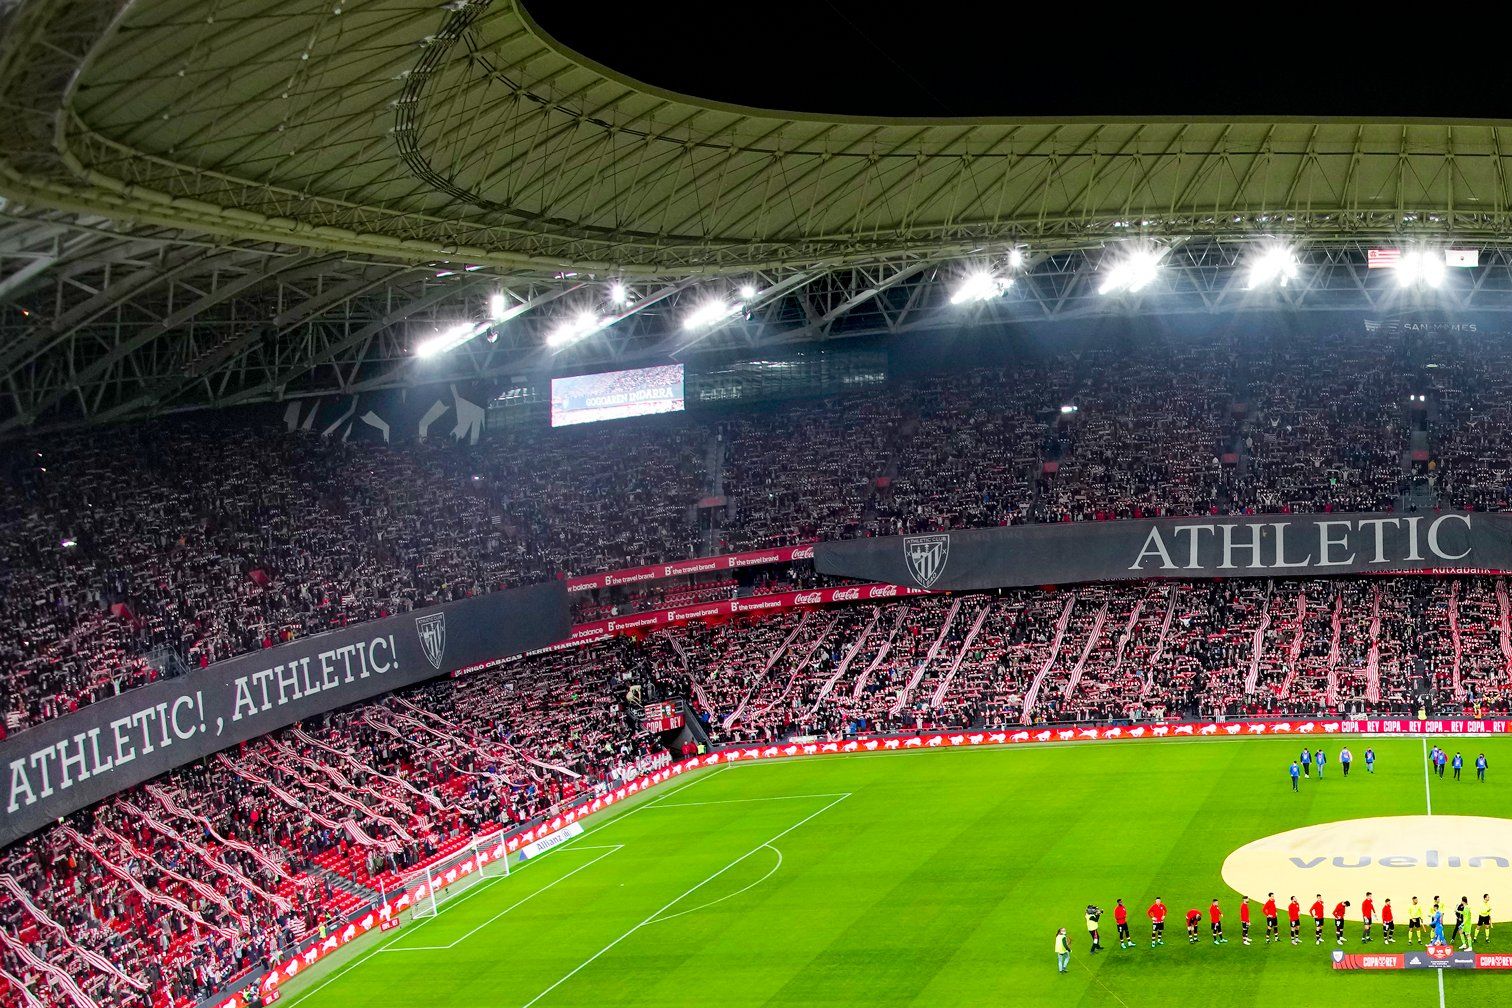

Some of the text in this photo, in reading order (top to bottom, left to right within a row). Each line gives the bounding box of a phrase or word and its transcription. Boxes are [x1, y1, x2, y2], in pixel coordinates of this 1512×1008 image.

[1403, 323, 1428, 331] SAN
[585, 387, 674, 407] GOGOAREN INDARRA
[1128, 514, 1472, 571] ATHLETIC
[746, 557, 762, 565] travel
[762, 554, 779, 564] brand
[673, 567, 682, 575] the
[683, 565, 699, 574] travel
[699, 563, 716, 573] brand
[612, 577, 622, 585] the
[622, 574, 638, 584] travel
[638, 572, 655, 582] brand
[574, 581, 597, 592] balance
[748, 601, 764, 610] travel
[764, 599, 782, 609] brand
[685, 610, 702, 619] travel
[702, 608, 719, 618] brand
[614, 622, 624, 631] the
[624, 619, 640, 629] travel
[640, 617, 657, 627] brand
[578, 626, 603, 637] balance
[232, 634, 400, 722] ATHLETIC!
[646, 715, 681, 735] COPA REY
[1341, 720, 1380, 732] COPA REY
[1383, 720, 1421, 732] COPA REY
[1425, 720, 1464, 732] COPA REY
[1467, 720, 1506, 732] COPA REY
[536, 835, 562, 851] Allianz
[1363, 957, 1397, 967] COPA REY
[1480, 956, 1495, 967] COPA
[1501, 956, 1512, 967] REY
